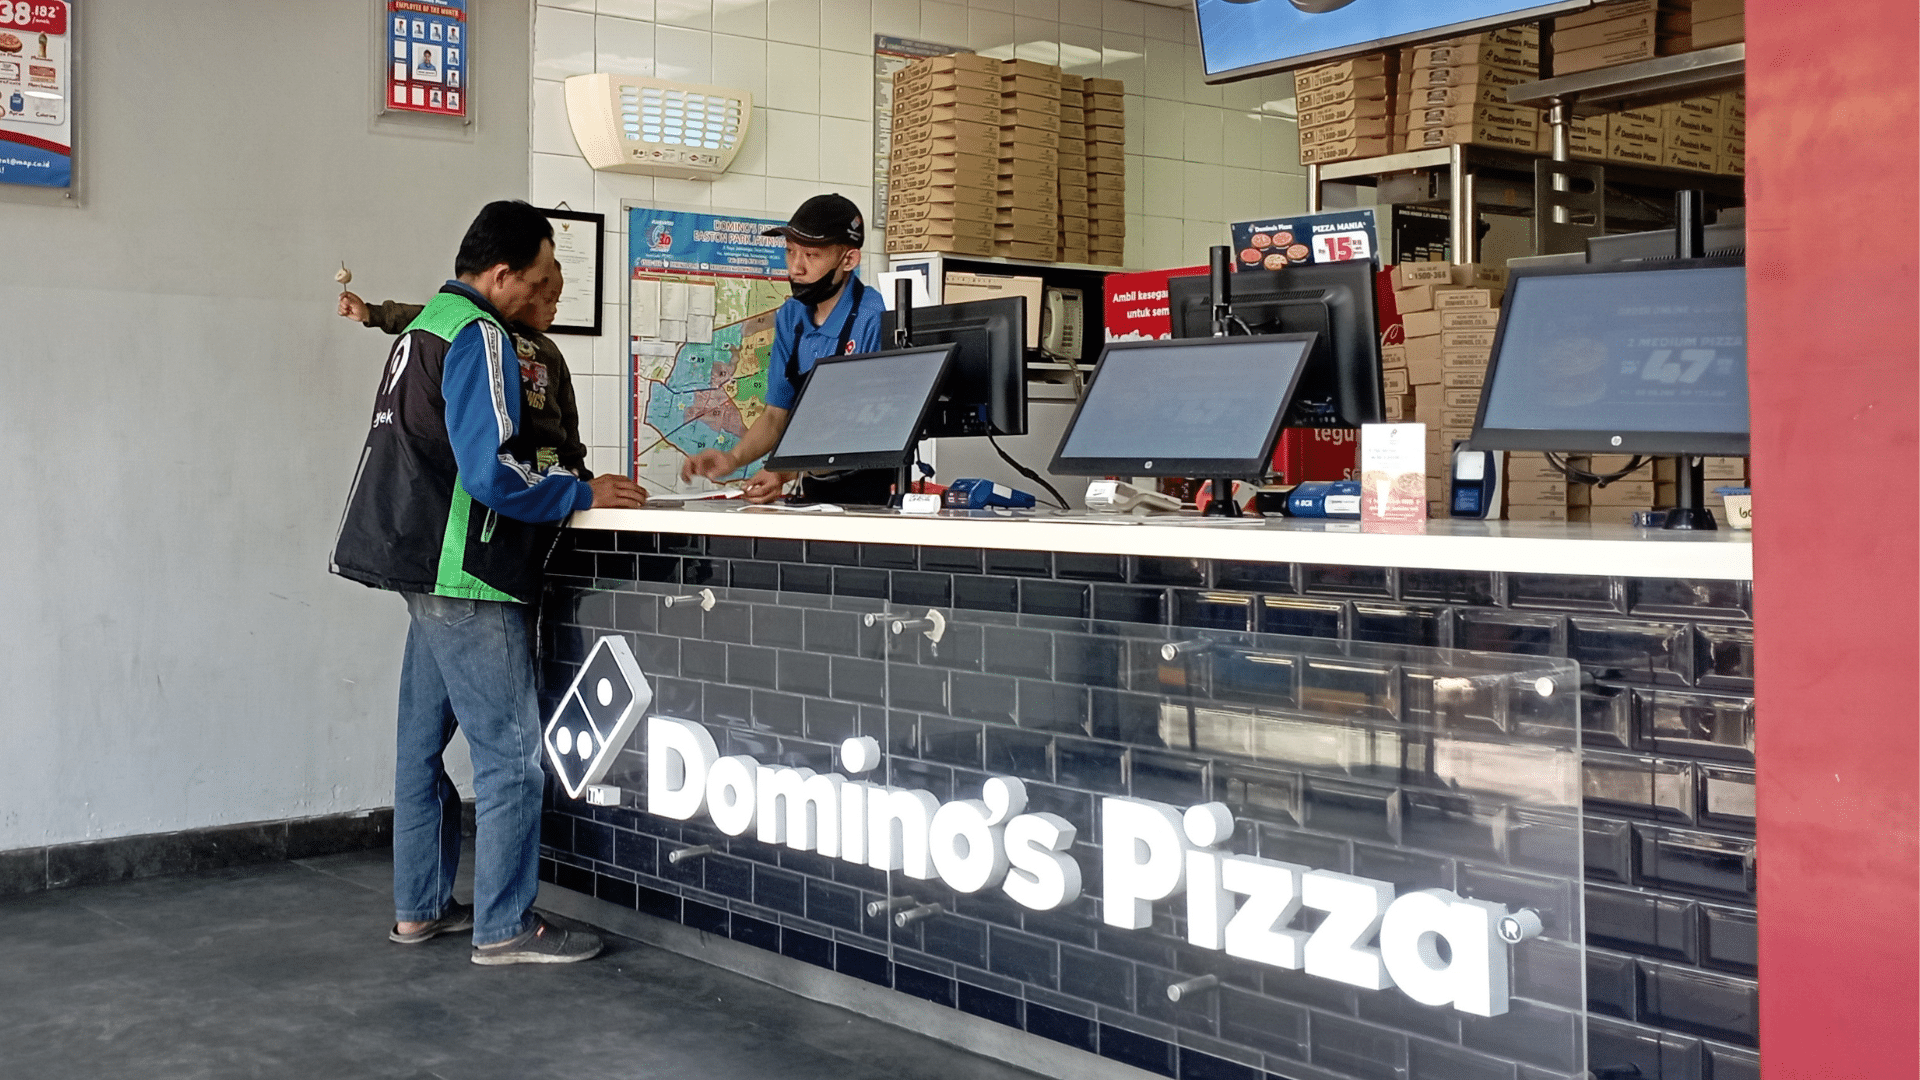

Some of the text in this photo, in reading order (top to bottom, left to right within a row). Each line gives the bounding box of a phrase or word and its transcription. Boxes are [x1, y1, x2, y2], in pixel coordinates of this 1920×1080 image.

[396, 2, 422, 11] EMPLOYEE
[430, 6, 440, 14] THE
[441, 8, 459, 16] MONTH
[1494, 55, 1539, 68] Domino's Pizza
[1488, 114, 1532, 127] Domino's Pizza
[1587, 127, 1601, 136] Pizza
[1621, 130, 1657, 143] Domino's Pizza
[1487, 134, 1530, 146] Domino's Pizza
[1588, 146, 1602, 154] Pizza
[1620, 150, 1656, 161] Domino's Pizza
[714, 219, 757, 234] DOMINO'S
[1312, 225, 1336, 233] PIZZA
[694, 230, 728, 243] EASTON
[729, 234, 751, 245] PARK
[1324, 237, 1353, 261] 15
[1112, 291, 1136, 303] Ambil
[1127, 307, 1170, 319] untuk sem
[1627, 336, 1743, 347] 2 MEDIUM PIZZA
[1641, 349, 1716, 384] 47
[373, 408, 394, 428] jek
[1314, 428, 1354, 446] tegu
[647, 716, 1078, 911] Domino's
[1102, 797, 1508, 1017] Pizza
